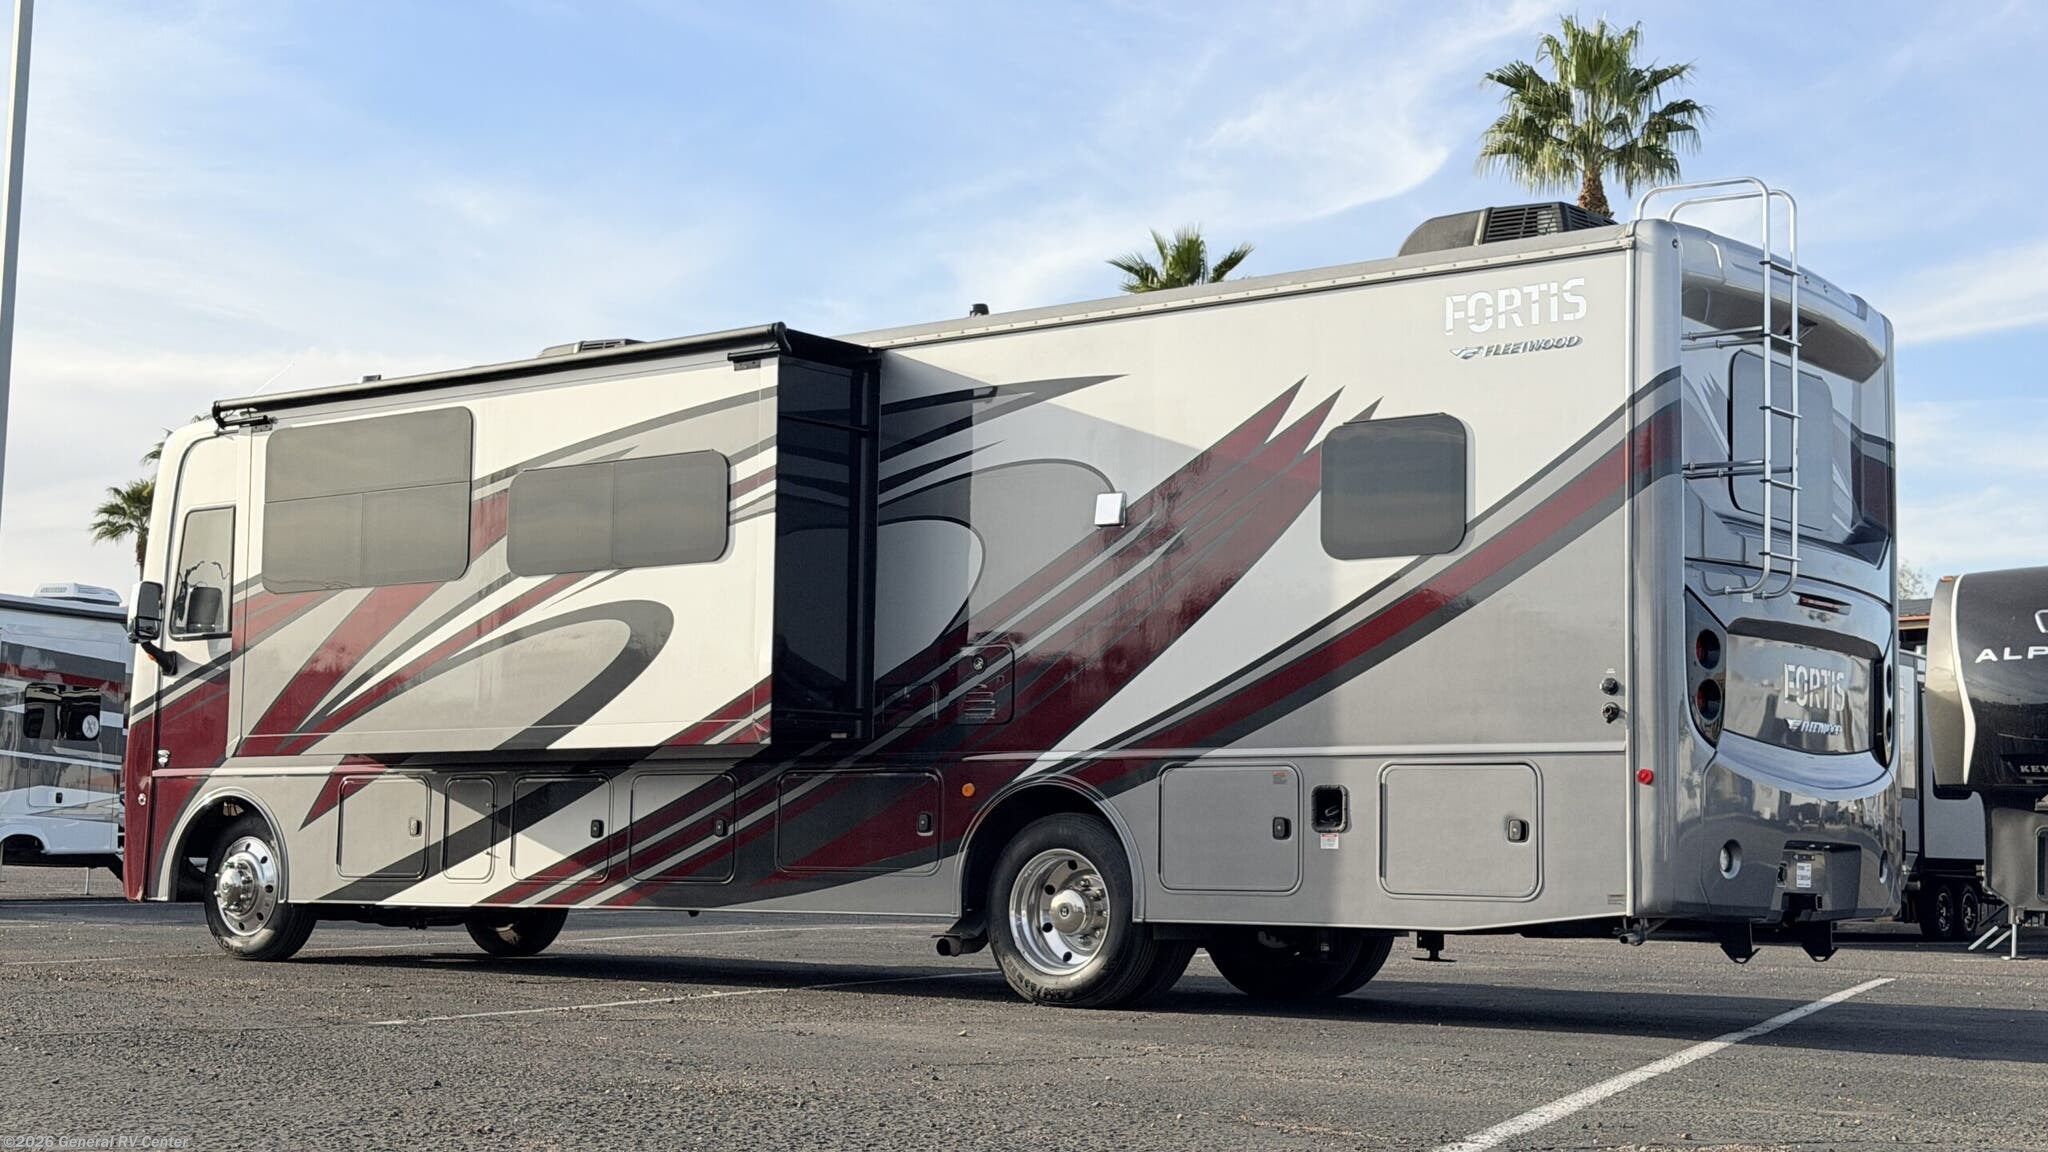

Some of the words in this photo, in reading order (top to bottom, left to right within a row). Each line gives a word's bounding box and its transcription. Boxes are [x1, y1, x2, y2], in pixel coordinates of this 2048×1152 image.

[1444, 278, 1587, 335] FORTIS
[1484, 336, 1583, 358] FLEETWOOD
[1975, 646, 2048, 664] ALP
[1783, 663, 1845, 712] FORTIS
